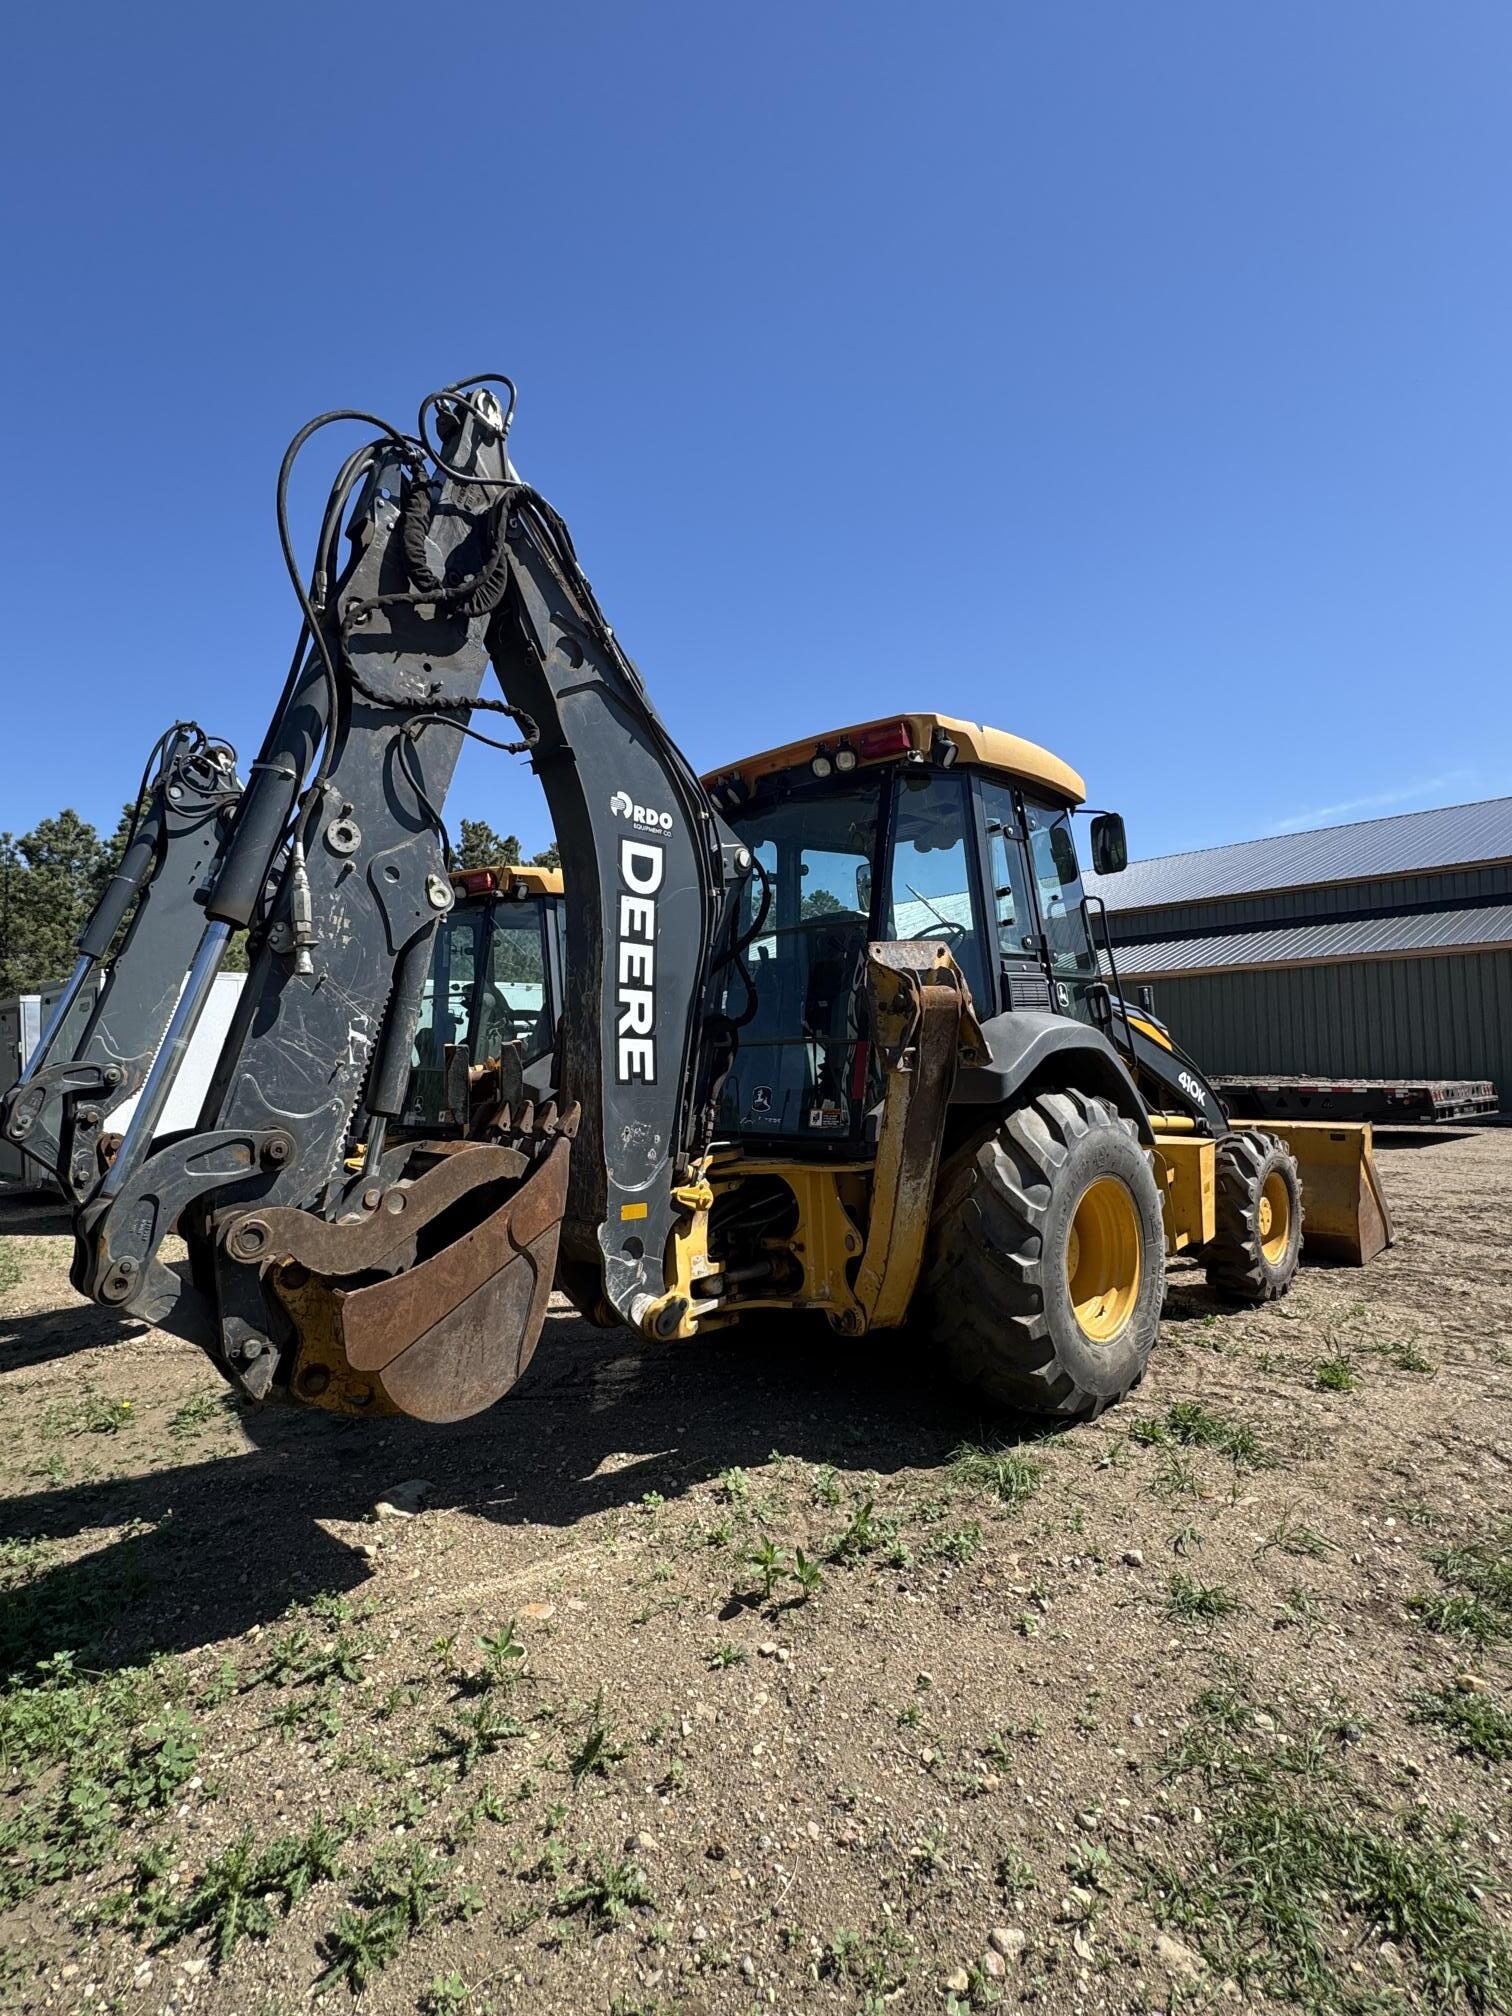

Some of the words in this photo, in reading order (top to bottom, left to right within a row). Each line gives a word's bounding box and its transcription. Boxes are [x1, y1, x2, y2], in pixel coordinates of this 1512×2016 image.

[633, 804, 673, 830] RDO
[633, 822, 663, 836] EQUIPMENT
[618, 839, 663, 1081] DEERE
[1178, 1071, 1206, 1107] 410K
